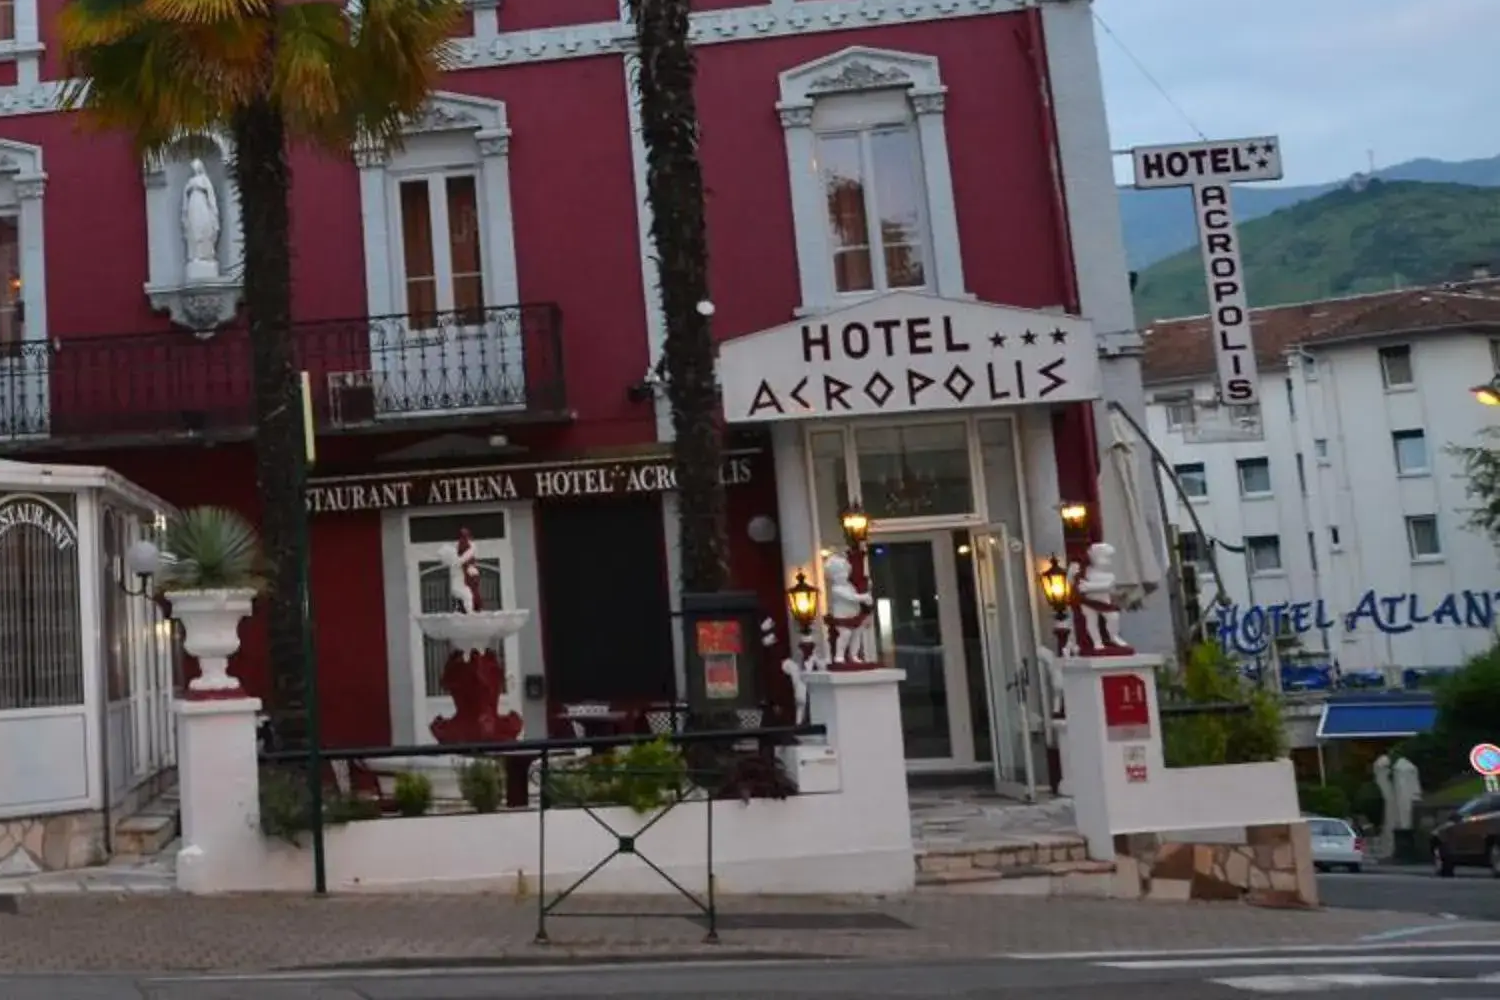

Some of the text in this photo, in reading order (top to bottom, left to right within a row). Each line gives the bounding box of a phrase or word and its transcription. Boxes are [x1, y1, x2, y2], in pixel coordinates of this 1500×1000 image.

[1142, 147, 1251, 180] HOTEL
[1201, 185, 1253, 400] ACROPOLIS
[802, 315, 970, 363] HOTEL
[747, 357, 1067, 417] ACROPOLIS
[305, 458, 753, 513] STAURANT ATHENA HOTEL ACRLIS
[1215, 598, 1335, 655] HOTEL
